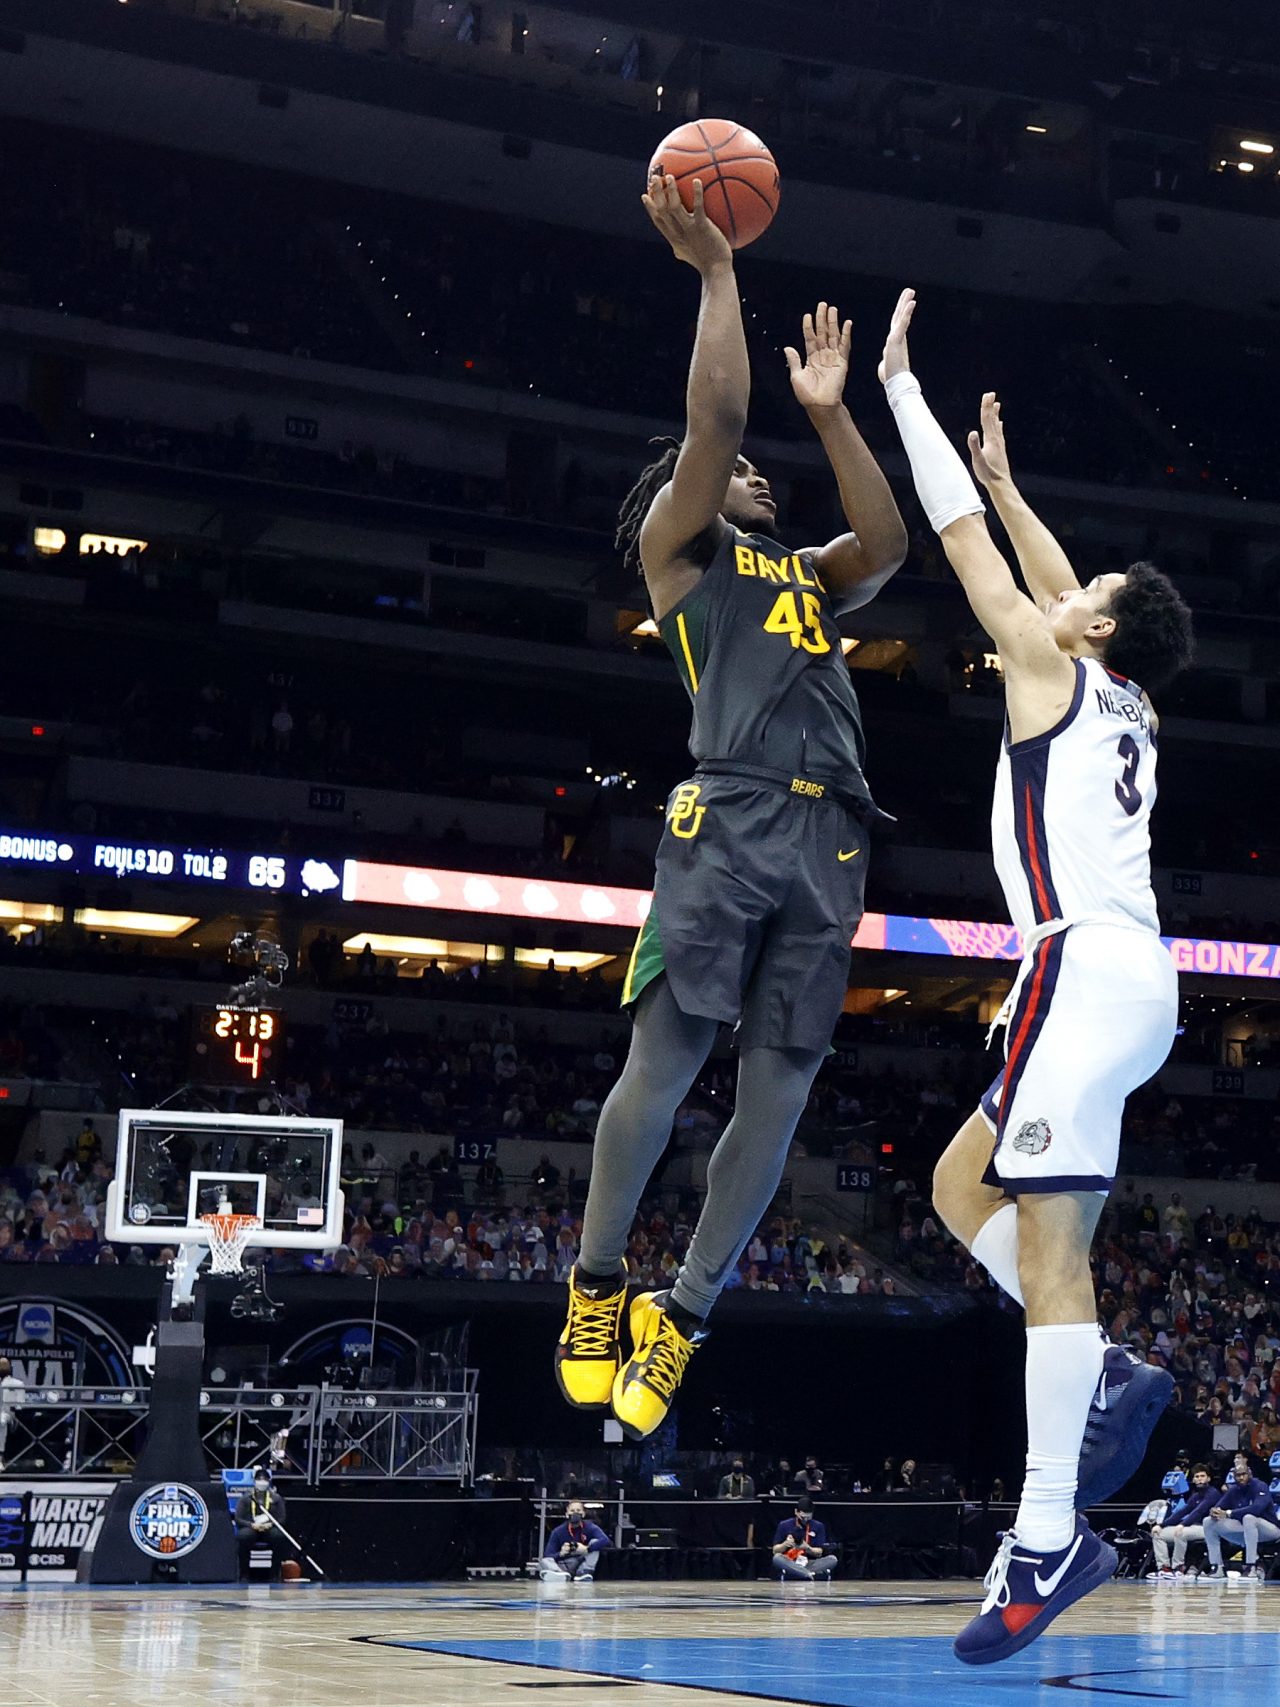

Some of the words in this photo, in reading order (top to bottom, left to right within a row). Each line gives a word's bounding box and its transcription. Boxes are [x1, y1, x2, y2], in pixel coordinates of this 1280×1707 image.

[735, 545, 827, 594] BAYL
[763, 591, 831, 654] 45
[1115, 734, 1142, 817] 3
[790, 778, 825, 799] BEARS
[666, 784, 707, 839] BU
[0, 835, 58, 862] BONUS
[249, 856, 286, 888] 65
[1174, 878, 1200, 891] 339
[337, 1003, 369, 1021] 237
[214, 1011, 274, 1040] 2:13
[234, 1040, 260, 1079] 4
[459, 1142, 493, 1160] 137
[840, 1170, 871, 1187] 138
[147, 1504, 192, 1519] FINAL
[146, 1521, 190, 1538] FOUR
[40, 1554, 65, 1566] CBS
